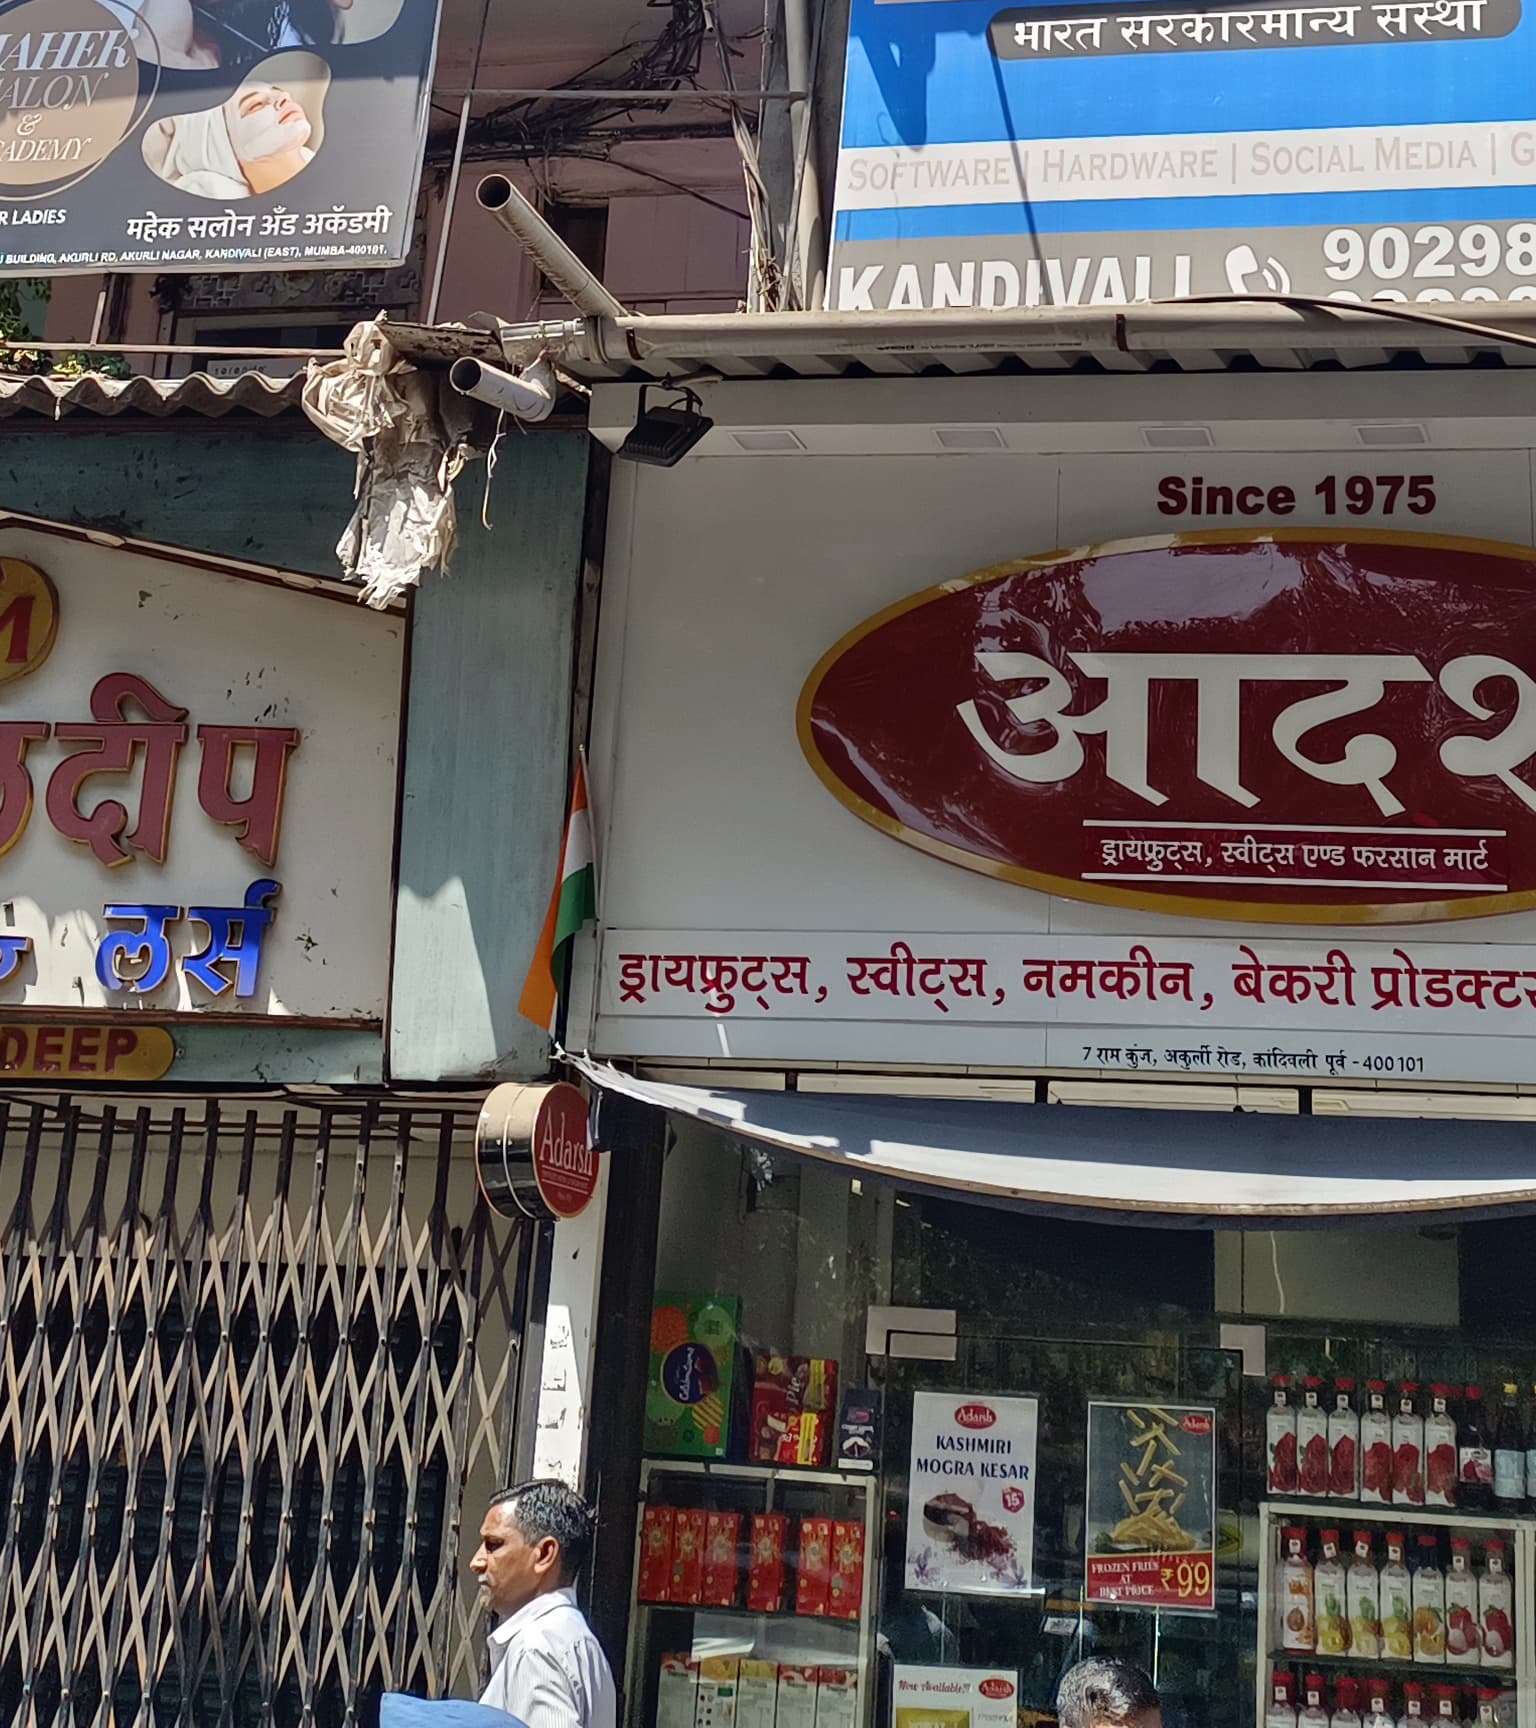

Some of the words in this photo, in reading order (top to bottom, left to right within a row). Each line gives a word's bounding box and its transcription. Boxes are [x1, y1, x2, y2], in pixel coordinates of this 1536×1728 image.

[1013, 17, 1107, 52] भारत
[1117, 5, 1361, 48] सरकारमान्य
[17, 113, 42, 135] &
[12, 208, 67, 225] LADIES
[127, 211, 183, 243] महेक
[188, 209, 255, 238] सलोन
[59, 252, 98, 263] AKURLI
[121, 250, 159, 261] AKURLI
[205, 248, 262, 259] KANDIVALI
[1157, 475, 1297, 517] Since
[1313, 475, 1436, 516] 1975
[1303, 844, 1346, 868] एण्ड
[1353, 845, 1436, 870] फरसान
[1443, 839, 1489, 871] मार्ट
[1023, 945, 1215, 1012] नमकीन,
[1231, 945, 1357, 1007] बेकरी
[1083, 1046, 1091, 1062] 7
[1096, 1047, 1121, 1065] राम
[1125, 1044, 1158, 1068] कुंज,
[1164, 1045, 1212, 1070] अकुर्ली
[1216, 1045, 1246, 1069] रोड,
[1253, 1047, 1318, 1070] कांदिवली
[1324, 1048, 1347, 1075] पूर्व
[539, 1106, 593, 1176] Adarsh
[936, 1435, 1012, 1455] KASHMIRI
[916, 1457, 975, 1477] MOGRA
[980, 1461, 1030, 1481] KESAR
[1091, 1561, 1130, 1574] FROZEN
[1119, 1573, 1132, 1584] AT
[1127, 1585, 1154, 1597] PRICE
